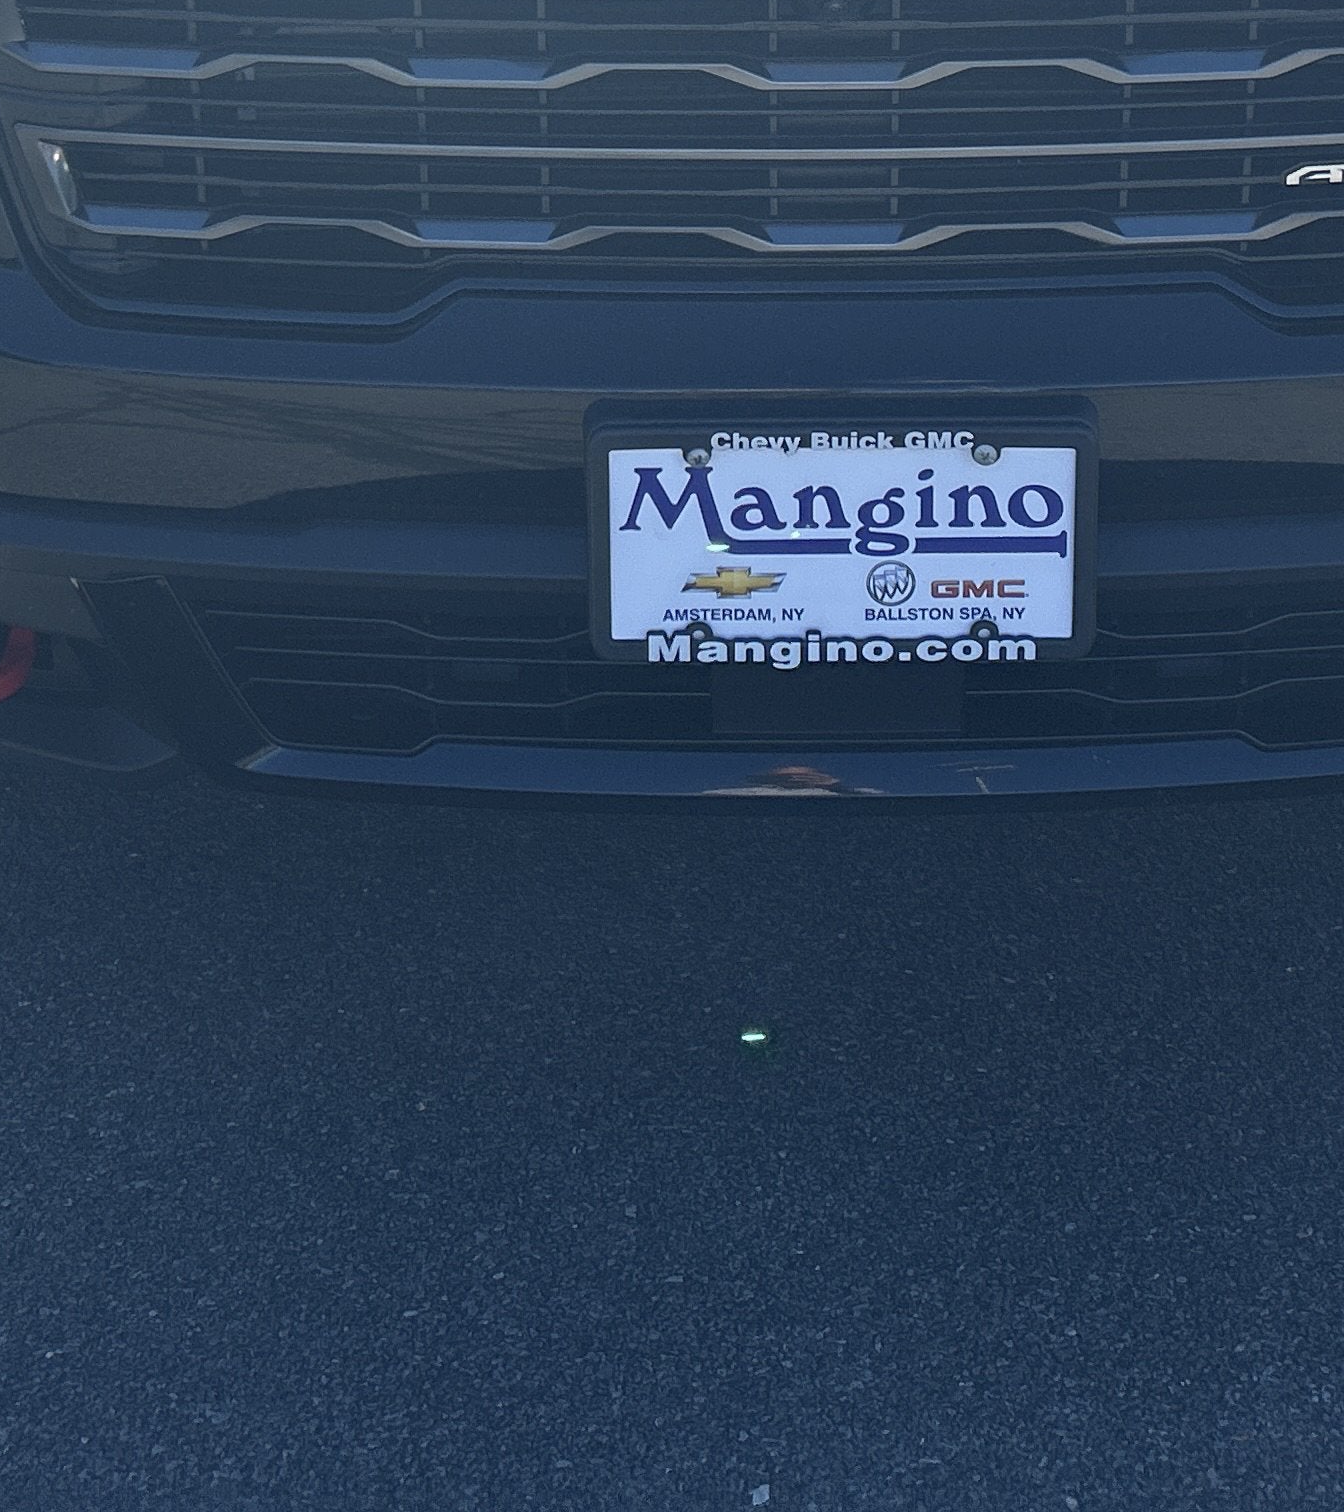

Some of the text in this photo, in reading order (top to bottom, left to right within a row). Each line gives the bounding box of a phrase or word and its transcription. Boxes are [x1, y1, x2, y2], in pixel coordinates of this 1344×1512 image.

[710, 431, 975, 455] Chevy Buick GMC
[619, 468, 1067, 557] Mangino
[931, 579, 1026, 598] GMC
[662, 608, 805, 623] AMSTERDAM, NY
[865, 607, 1025, 621] BALLSTON SPA, NY
[648, 633, 1037, 670] Mangino.com
